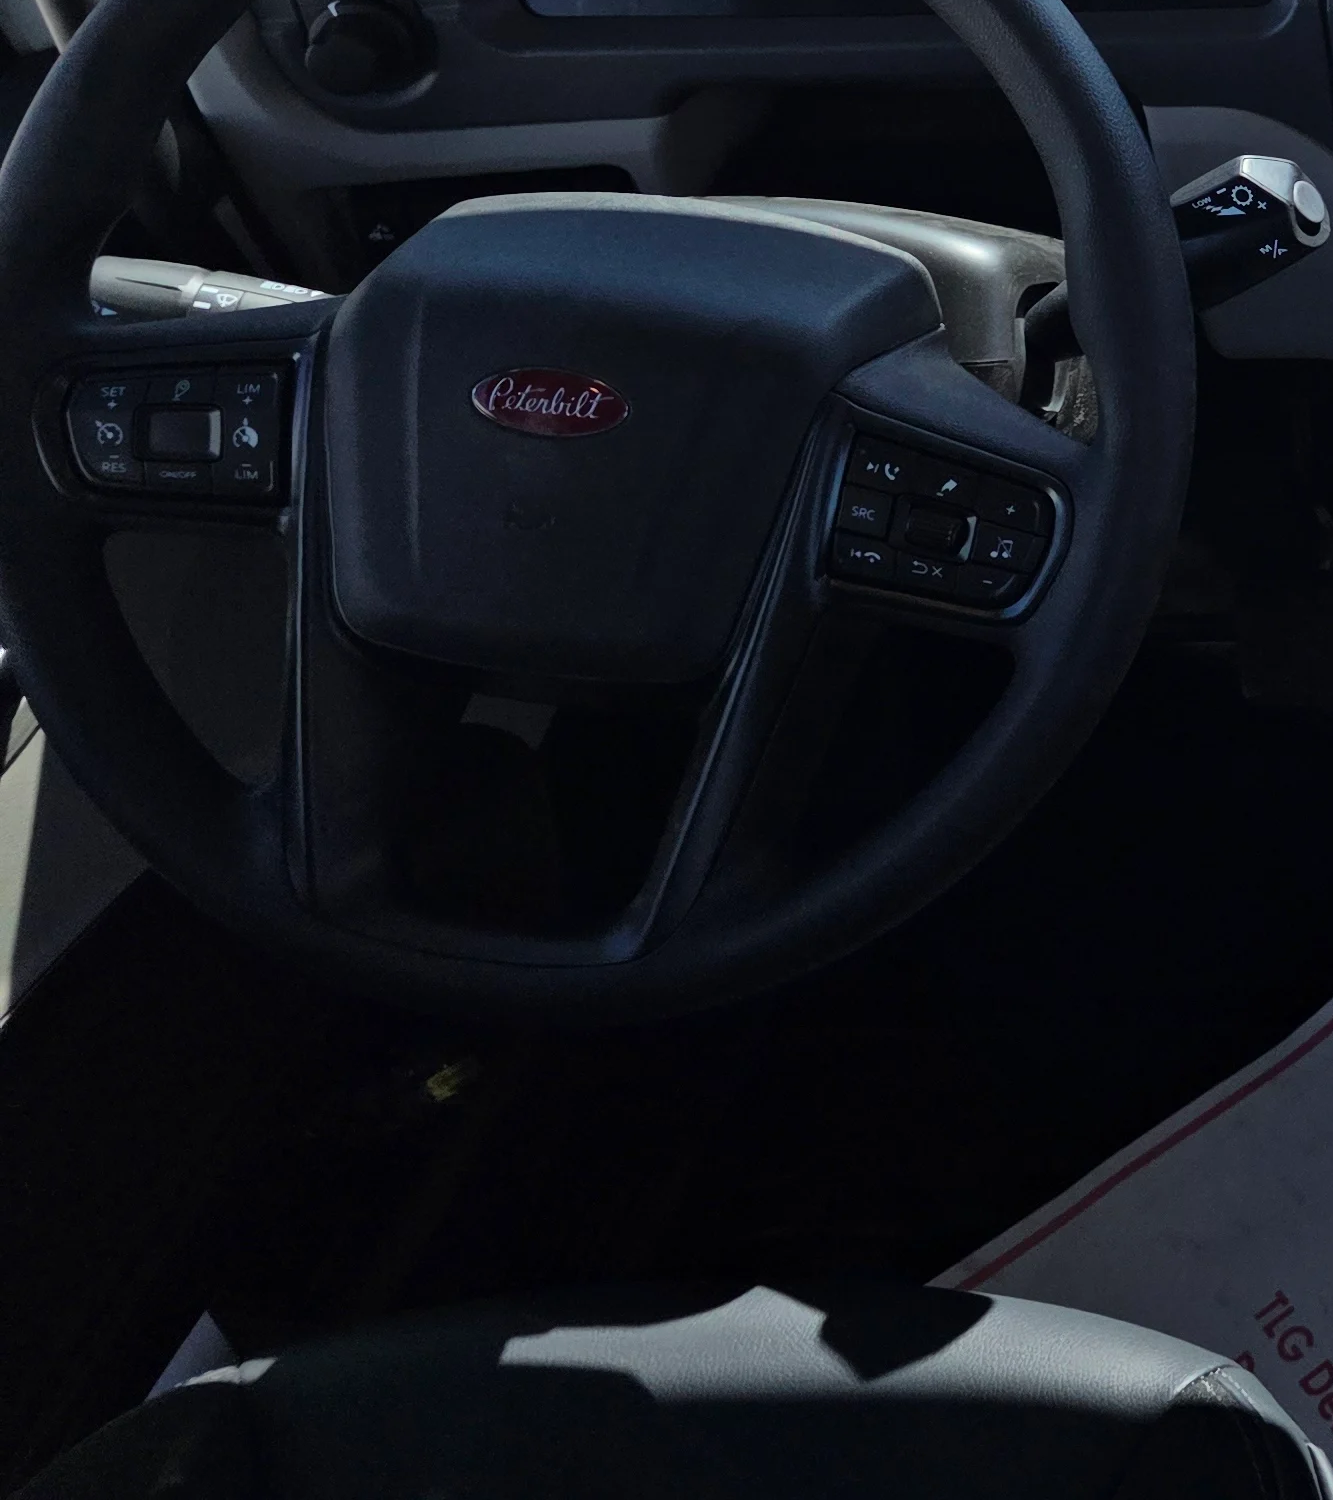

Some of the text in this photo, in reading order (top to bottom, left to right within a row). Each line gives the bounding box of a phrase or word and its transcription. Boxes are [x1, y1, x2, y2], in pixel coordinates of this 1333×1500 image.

[1191, 196, 1212, 209] LOW
[100, 385, 126, 397] SET
[237, 383, 261, 395] LIM
[488, 377, 615, 419] Peterbilt
[101, 461, 126, 473] RES
[234, 468, 259, 480] LIM
[851, 505, 876, 522] SRC
[1253, 1290, 1315, 1363] TLG
